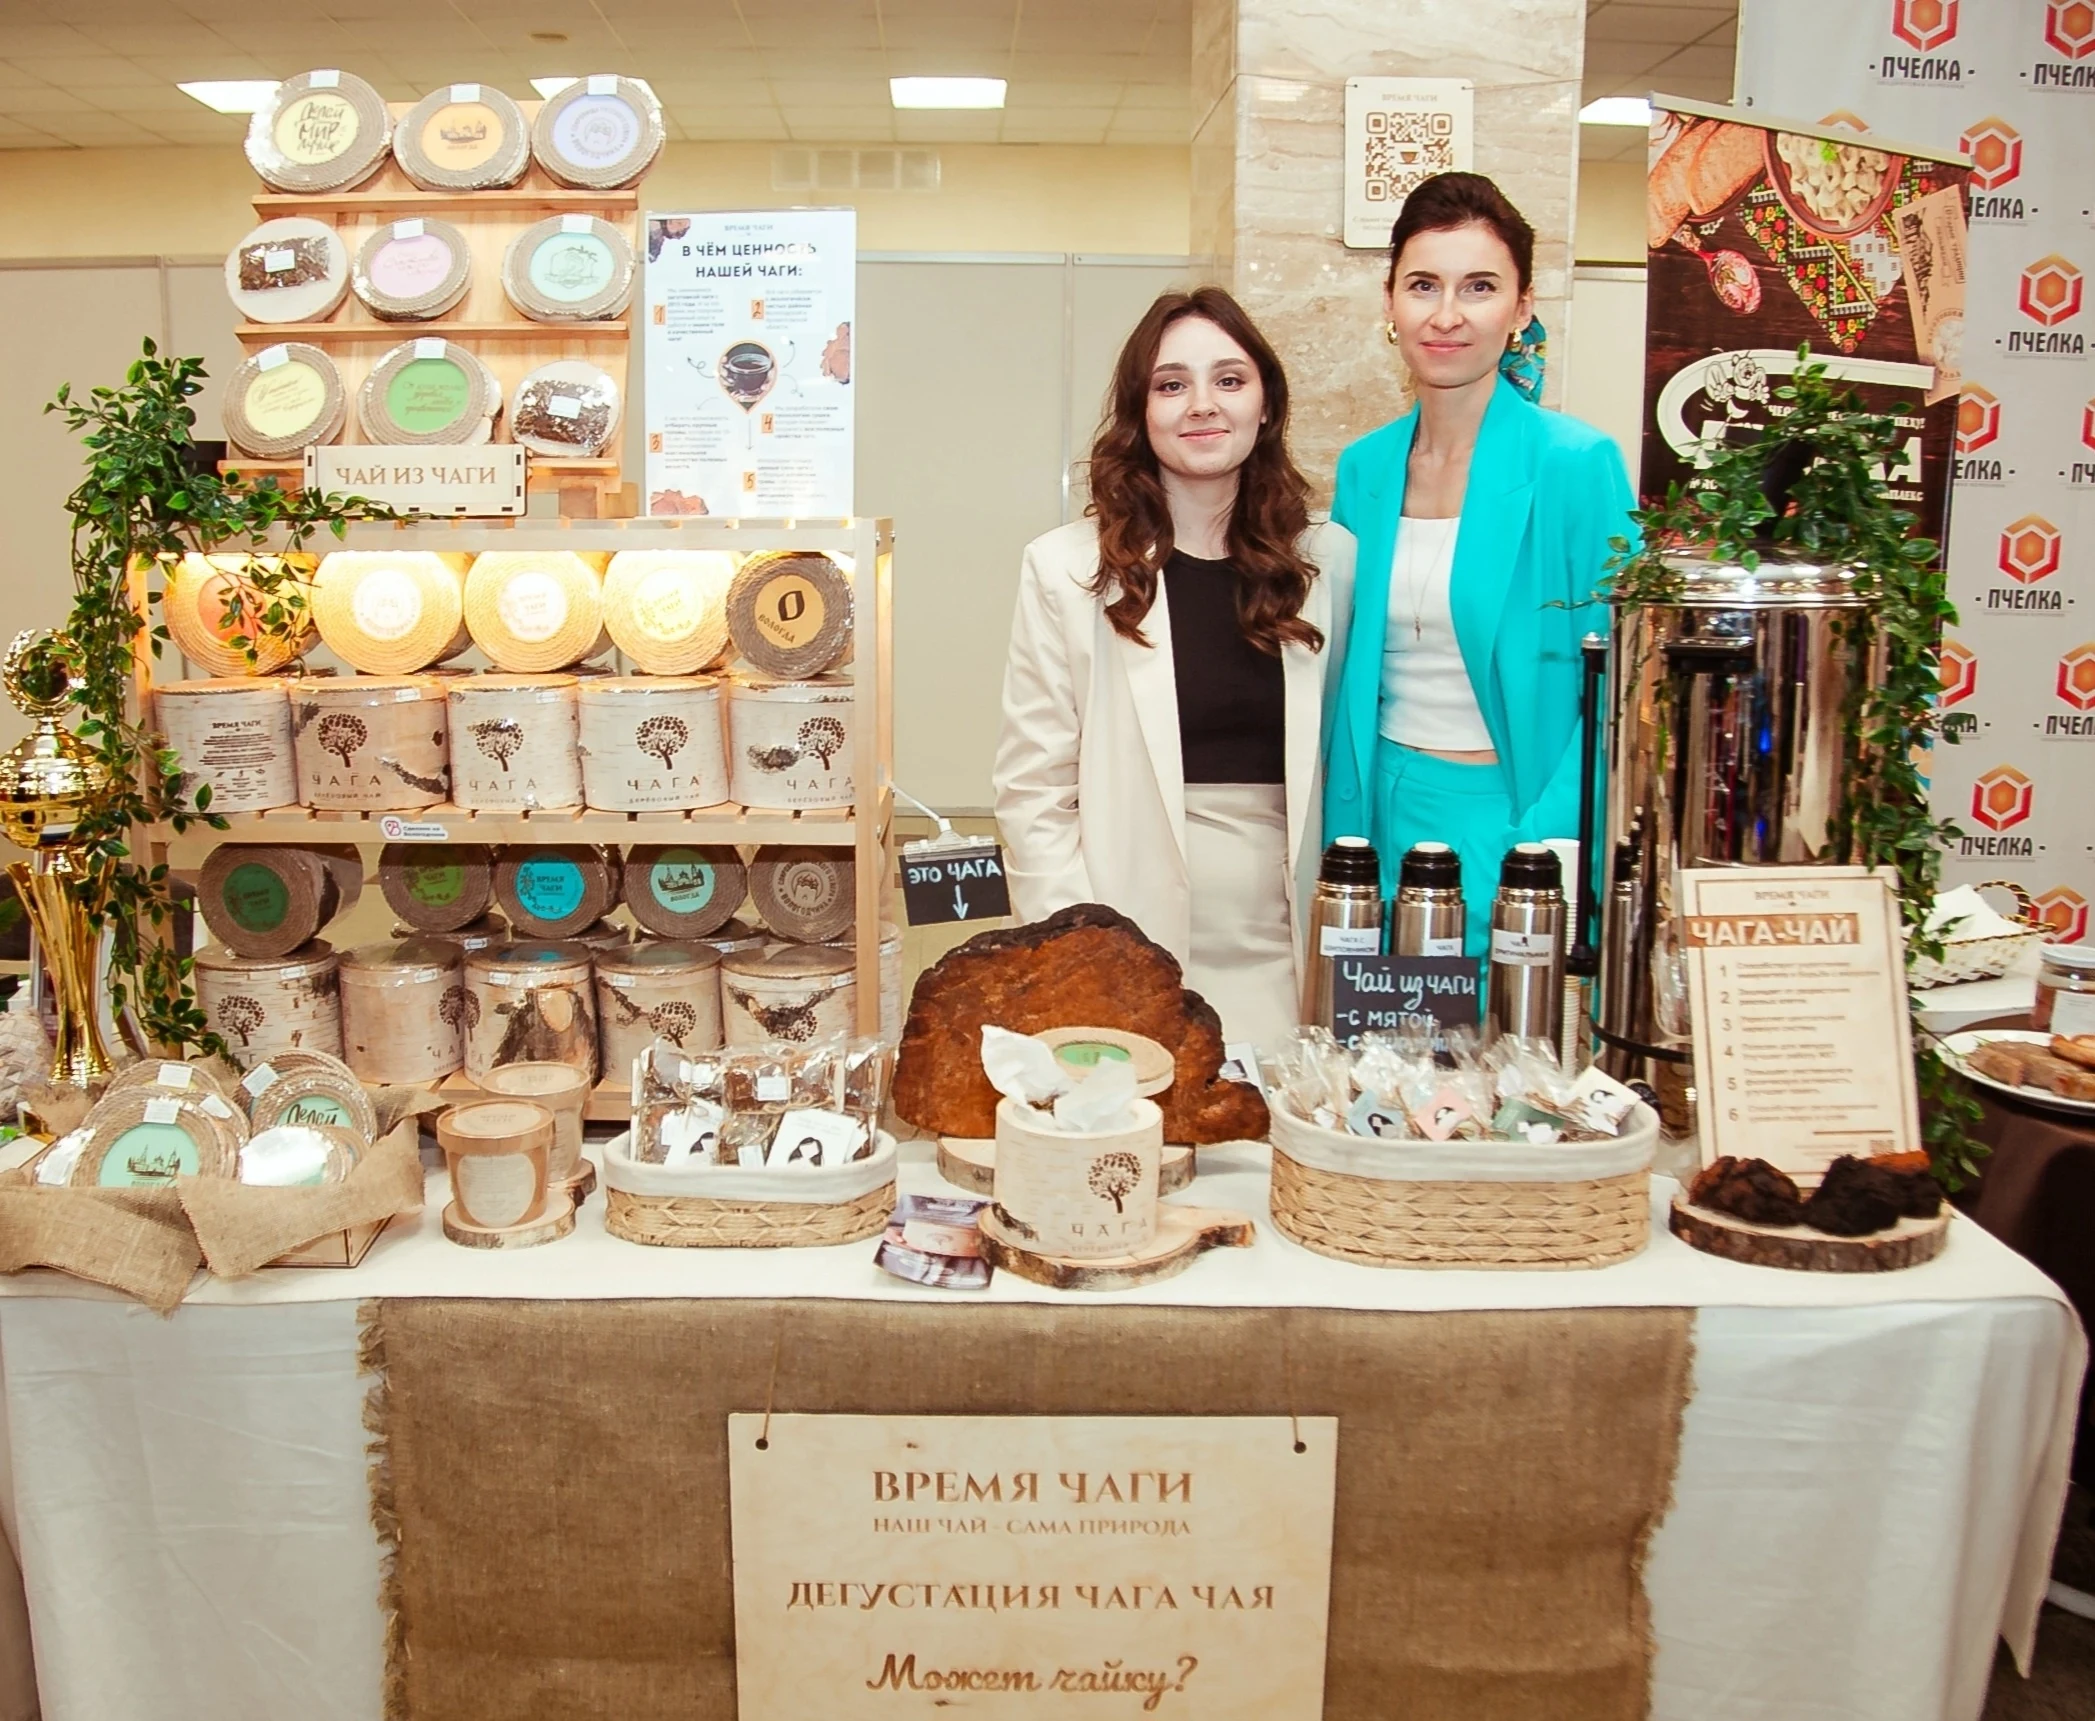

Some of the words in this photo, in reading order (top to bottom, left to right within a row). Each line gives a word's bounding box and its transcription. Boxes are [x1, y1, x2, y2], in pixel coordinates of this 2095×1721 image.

[1881, 56, 1961, 81] ПЧЕЛКА
[1969, 196, 2024, 219] ЕЛКА
[682, 245, 691, 257] В
[696, 242, 727, 257] ЧЁМ
[696, 262, 753, 277] НАШЕЙ
[757, 264, 803, 276] ЧАГИ:
[2008, 331, 2084, 354] ПЧЕЛКА
[764, 415, 773, 431] 4
[335, 461, 387, 485] ЧАЙ
[394, 466, 425, 485] ИЗ
[430, 466, 497, 485] ЧАГИ
[746, 473, 755, 489] 5
[1988, 588, 2062, 610] ПЧЕЛКА
[758, 614, 796, 643] ВОЛОГДА
[212, 721, 239, 729] ВРЕМЯ
[241, 720, 261, 728] ЧАГИ
[312, 774, 382, 787] ЧАГА
[469, 778, 537, 791] ЧАГА
[627, 775, 700, 791] ЧАГА
[786, 776, 853, 791] ЧАГА
[1960, 836, 2033, 856] ПЧЕЛКА
[536, 875, 565, 883] ВРЕМЯ
[907, 866, 942, 884] ЭТО
[947, 858, 1003, 882] ЧАГА
[539, 884, 563, 892] ЧАГИ
[1755, 890, 1794, 900] ВРЕМЯ
[1797, 890, 1830, 900] ЧАГИ
[1691, 914, 1852, 946] ЧАГА-ЧАЙ
[1720, 965, 1727, 978] 1
[1342, 960, 1396, 993] Чай
[1399, 975, 1424, 1011] из
[1720, 991, 1730, 1005] 2
[1722, 1018, 1732, 1032] 3
[1724, 1045, 1734, 1057] 4
[1727, 1077, 1738, 1091] 5
[1728, 1108, 1739, 1122] 6
[1071, 1217, 1148, 1238] ЧАГА
[872, 1470, 1039, 1504] ВРЕМЯ
[1057, 1471, 1193, 1505] ЧАГИ
[873, 1518, 932, 1534] НАШ
[938, 1515, 987, 1535] ЧАЙ
[1005, 1518, 1073, 1536] САМА
[1078, 1518, 1192, 1538] ПРИРОДА
[786, 1581, 1061, 1614] ДЕГУСТАЦИЯ
[1074, 1584, 1180, 1611] ЧАГА
[1191, 1585, 1276, 1612] ЧАЯ
[865, 1653, 1042, 1694] Может
[1049, 1655, 1199, 1713] чайку?
